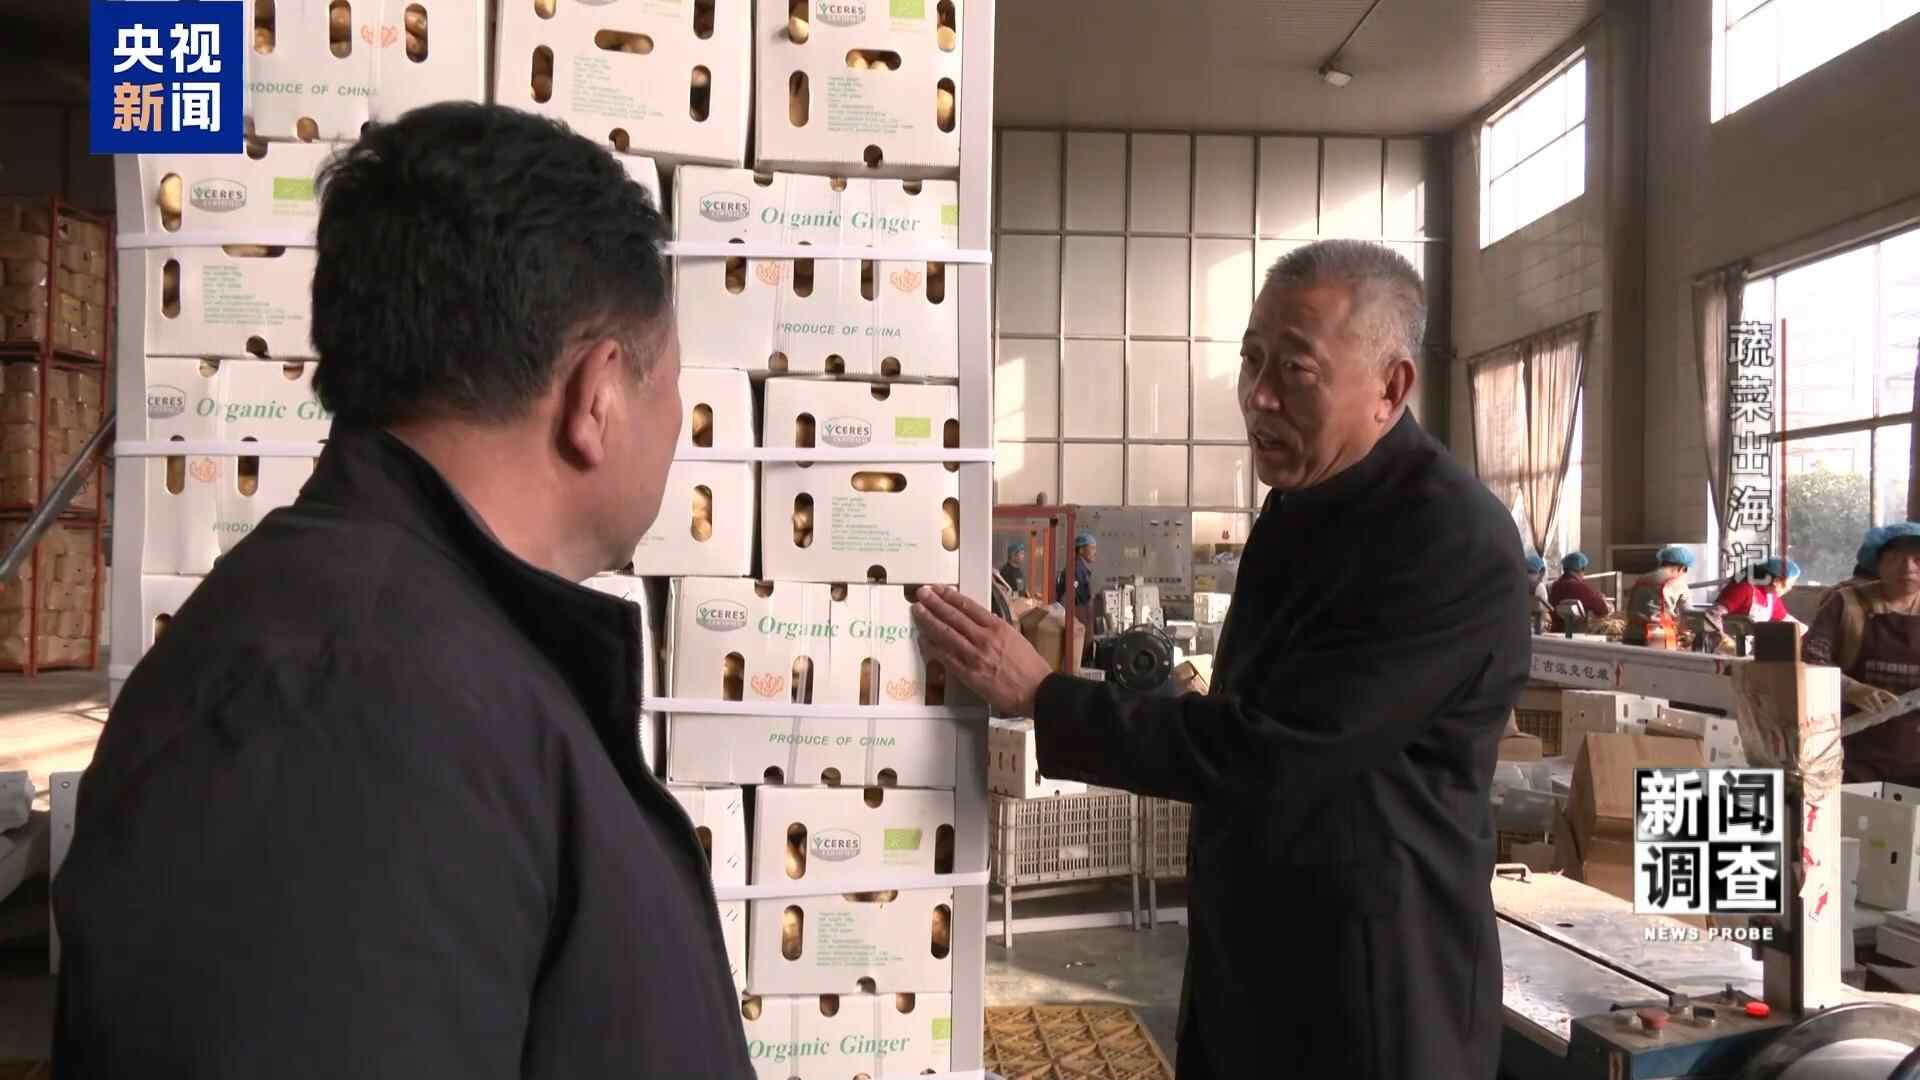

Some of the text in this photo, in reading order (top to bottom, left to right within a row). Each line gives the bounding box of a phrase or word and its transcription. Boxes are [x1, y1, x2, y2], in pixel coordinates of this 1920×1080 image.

[829, 4, 864, 14] CERES
[249, 83, 303, 94] RODUCE
[311, 84, 329, 95] OF
[204, 188, 243, 199] CERES
[713, 201, 748, 210] CERES
[776, 322, 901, 336] PRODUCE OF CINA
[147, 395, 183, 407] CERES
[196, 397, 287, 422] Oganic
[835, 424, 870, 436] CERES
[711, 608, 745, 620] CERES
[758, 615, 839, 640] Organic
[768, 733, 829, 746] PRODUCE
[836, 736, 854, 746] OF
[824, 839, 859, 849] CERES
[749, 1037, 830, 1063] Organic
[840, 1034, 910, 1060] Ginger
